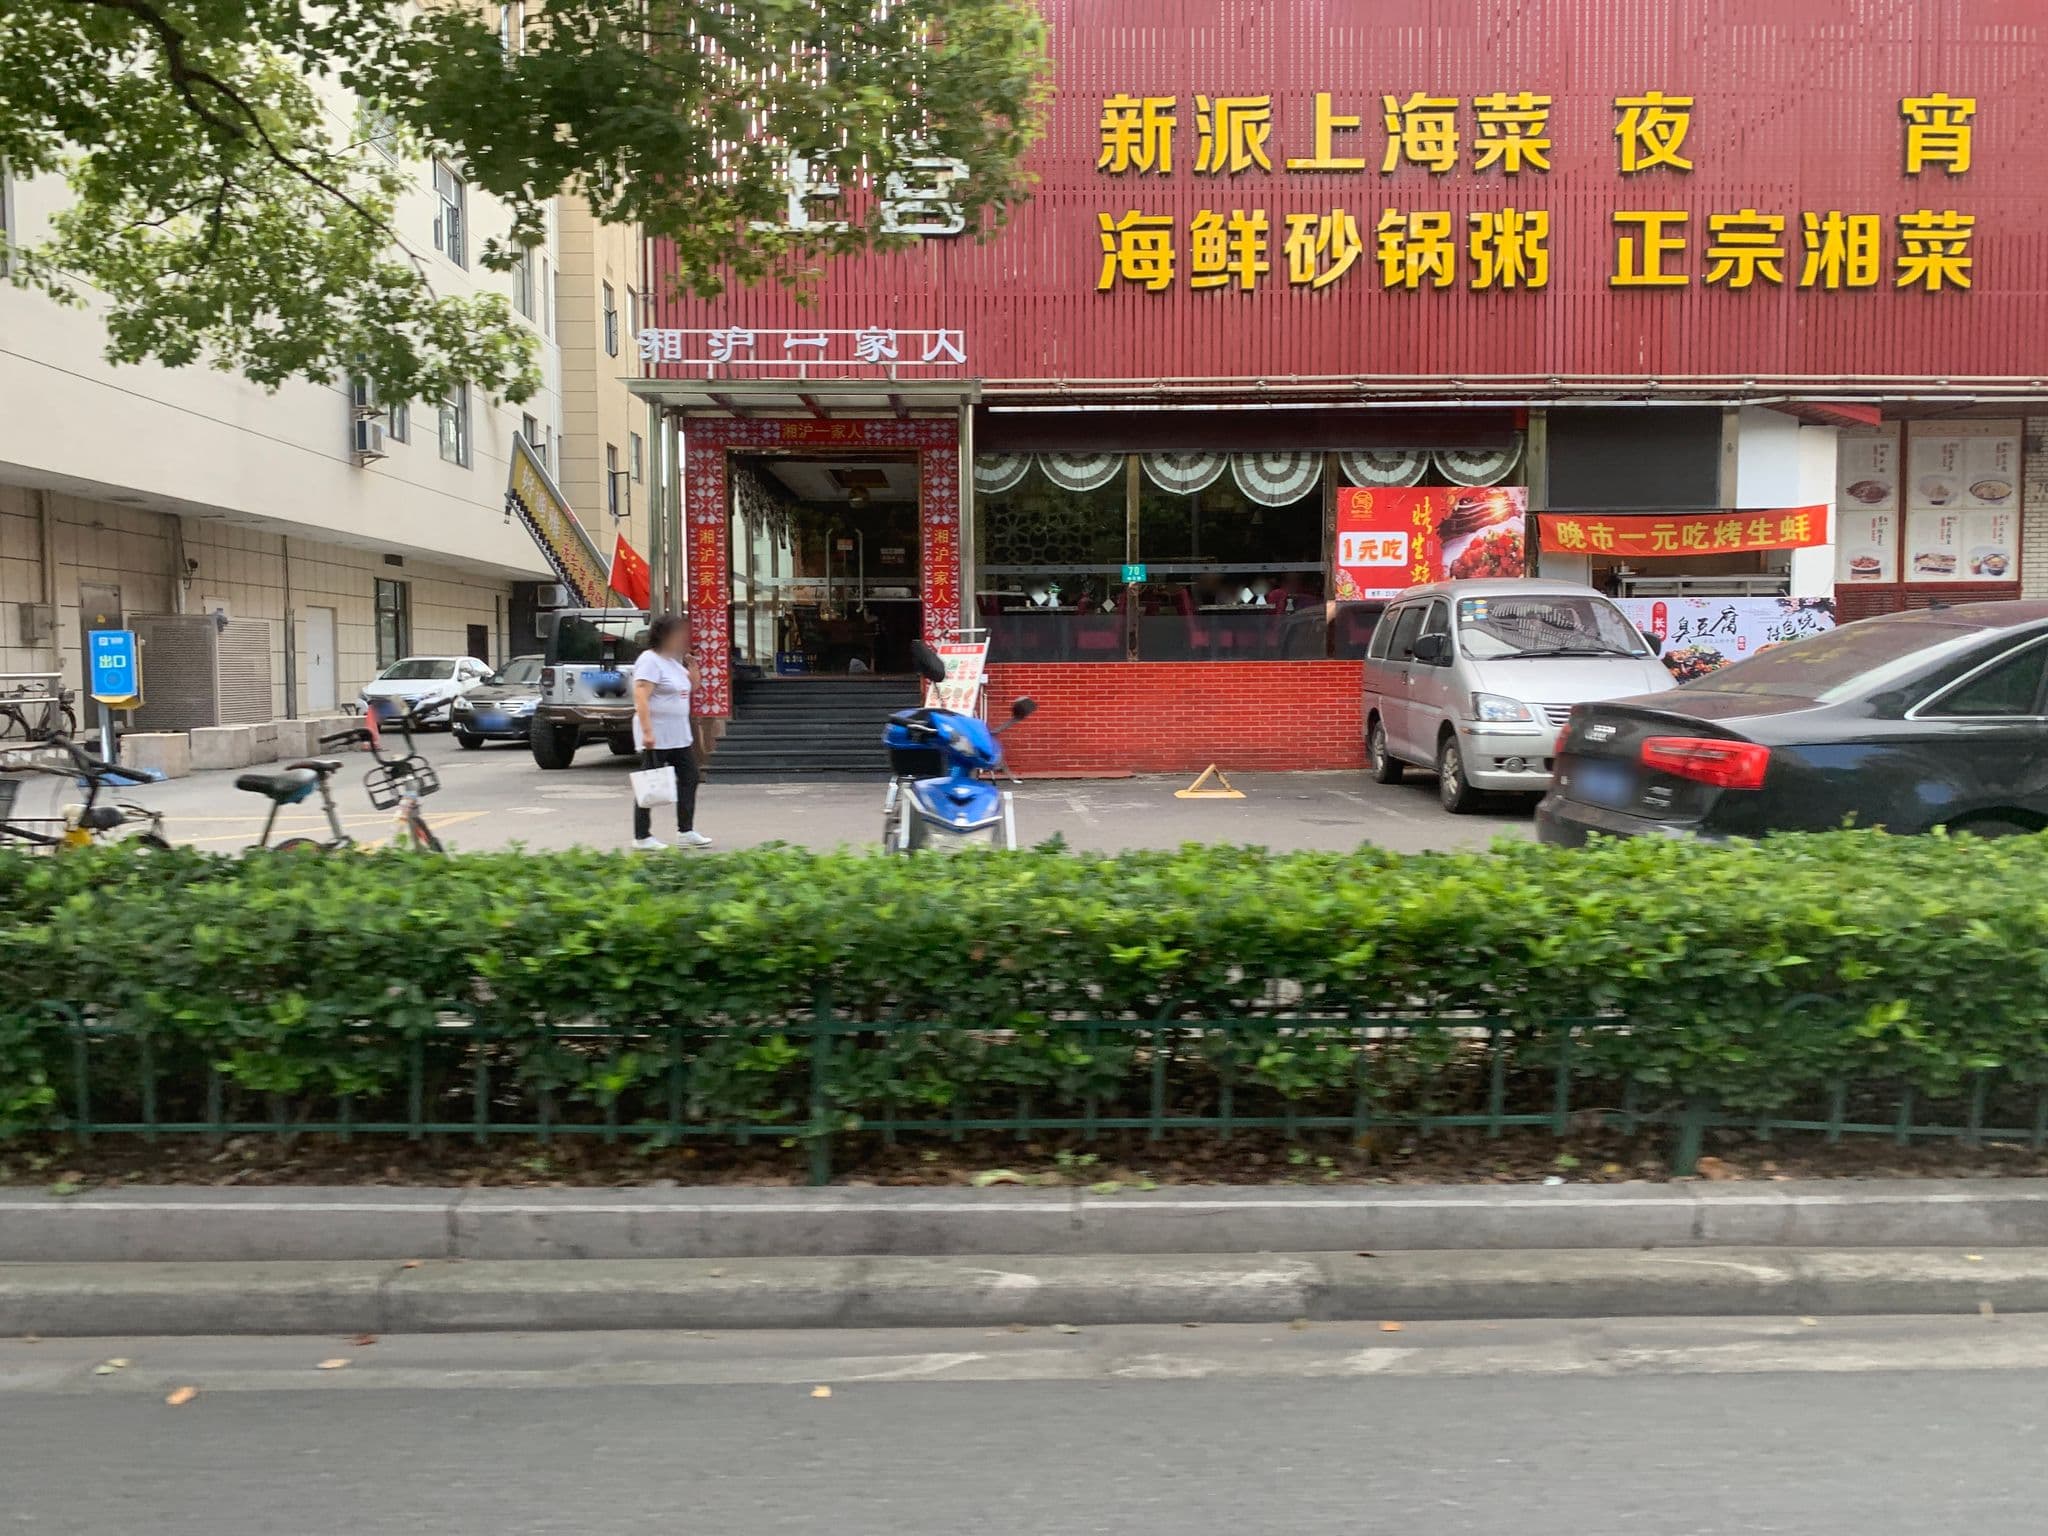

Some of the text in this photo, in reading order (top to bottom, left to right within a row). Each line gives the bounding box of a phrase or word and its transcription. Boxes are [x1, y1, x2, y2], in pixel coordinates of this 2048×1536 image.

[1098, 92, 1552, 175] 新派上海菜
[1098, 207, 1976, 291] 海鲜砂锅粥 正宗湘菜
[638, 326, 967, 363] 湘沪一家人
[782, 423, 864, 439] 湘沪一家人
[1556, 512, 1812, 550] 晚市一元吃烤生蚝
[699, 529, 716, 605] 湘沪一家人
[933, 529, 950, 604] 湘沪一家人
[1670, 604, 1739, 643] 臭豆腐
[1766, 610, 1826, 641] 特色烧
[99, 654, 127, 669] 出口
